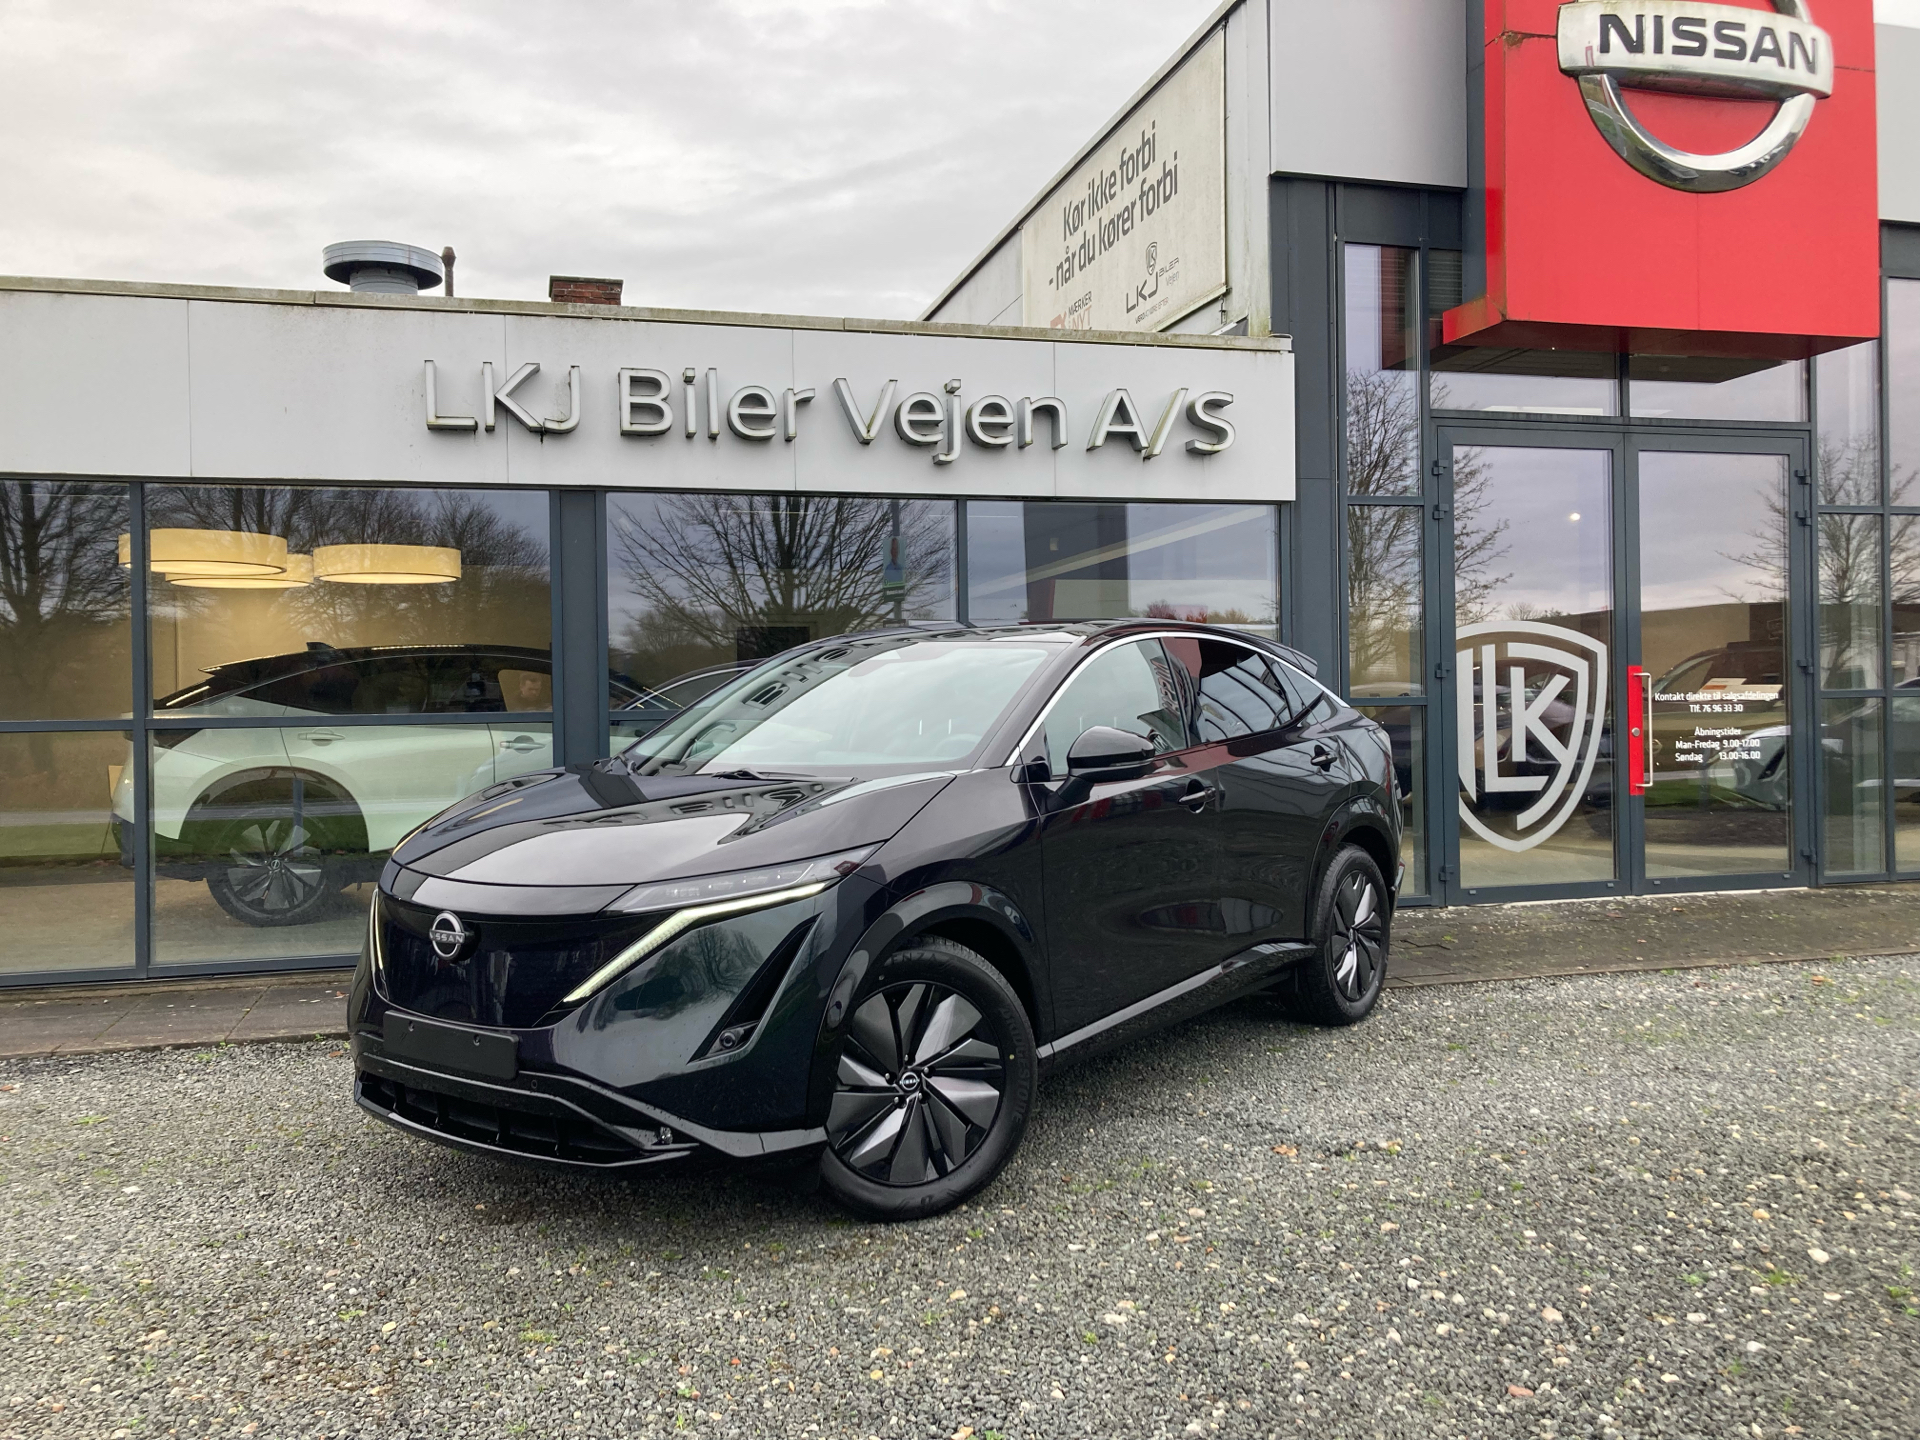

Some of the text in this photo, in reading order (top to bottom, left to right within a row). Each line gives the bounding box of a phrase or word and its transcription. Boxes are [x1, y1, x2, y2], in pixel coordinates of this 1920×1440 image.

[1599, 14, 1817, 75] NISSAN
[1063, 119, 1156, 242] Kør ikke forbi
[1056, 245, 1077, 291] når
[1078, 230, 1096, 272] du
[1098, 198, 1137, 256] kører
[1138, 150, 1178, 222] forbi
[1126, 271, 1158, 314] LKJ
[424, 360, 1237, 466] LKJ Biler Vejen A/S
[1654, 691, 1779, 702] Kontakt direkte til salgsafdelingen
[1702, 704, 1711, 713] 76
[1712, 704, 1722, 713] 96
[1723, 704, 1732, 713] 33
[1734, 704, 1743, 712] 30
[1694, 726, 1741, 737] Åbningstider
[1675, 739, 1760, 751] Man-Fredag 9.00-17.00
[1675, 751, 1760, 762] Søndag 13.00-16.00
[891, 952, 938, 965] ENZA
